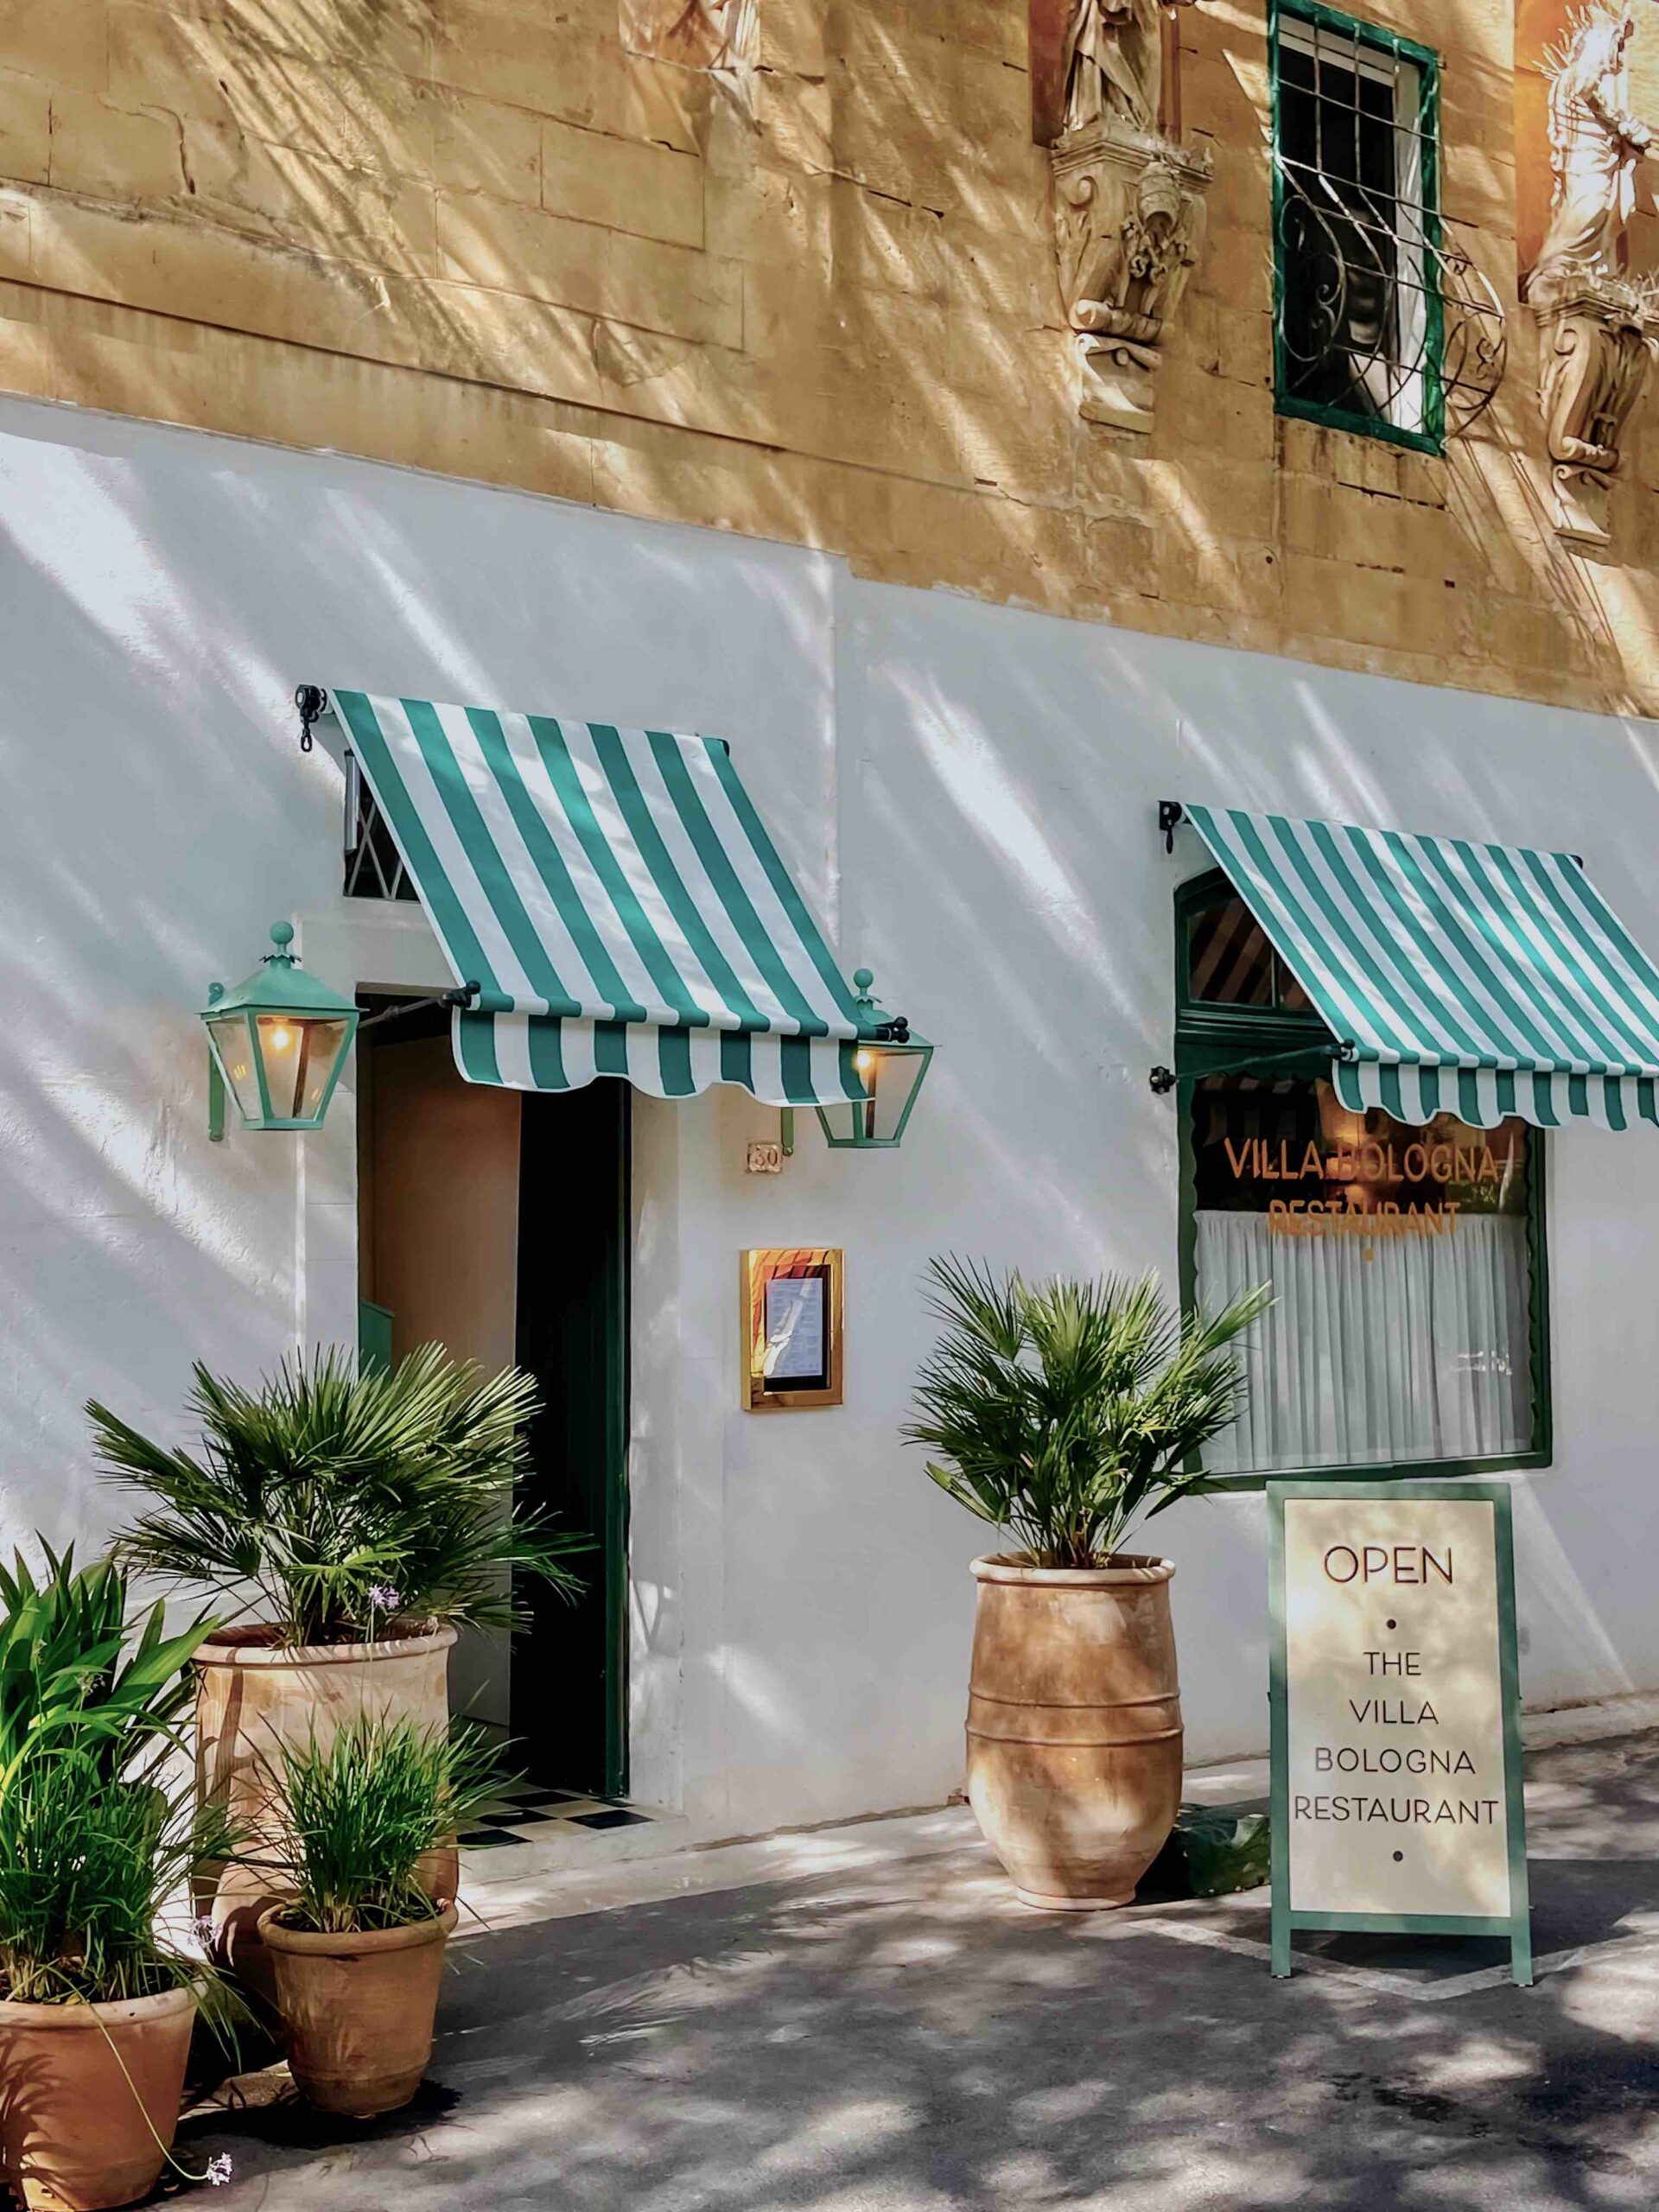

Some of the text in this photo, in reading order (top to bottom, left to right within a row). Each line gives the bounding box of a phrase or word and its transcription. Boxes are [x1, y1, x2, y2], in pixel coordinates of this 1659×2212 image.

[1224, 1136, 1500, 1183] VILLA BOLOGNA
[1268, 1199, 1461, 1238] RESTAURANT
[1323, 1545, 1454, 1585] OPEN
[1363, 1651, 1422, 1676] THE
[1349, 1699, 1440, 1726] VILLA
[1314, 1746, 1477, 1775] BOLOGNA
[1294, 1795, 1499, 1825] RESTAURANT
